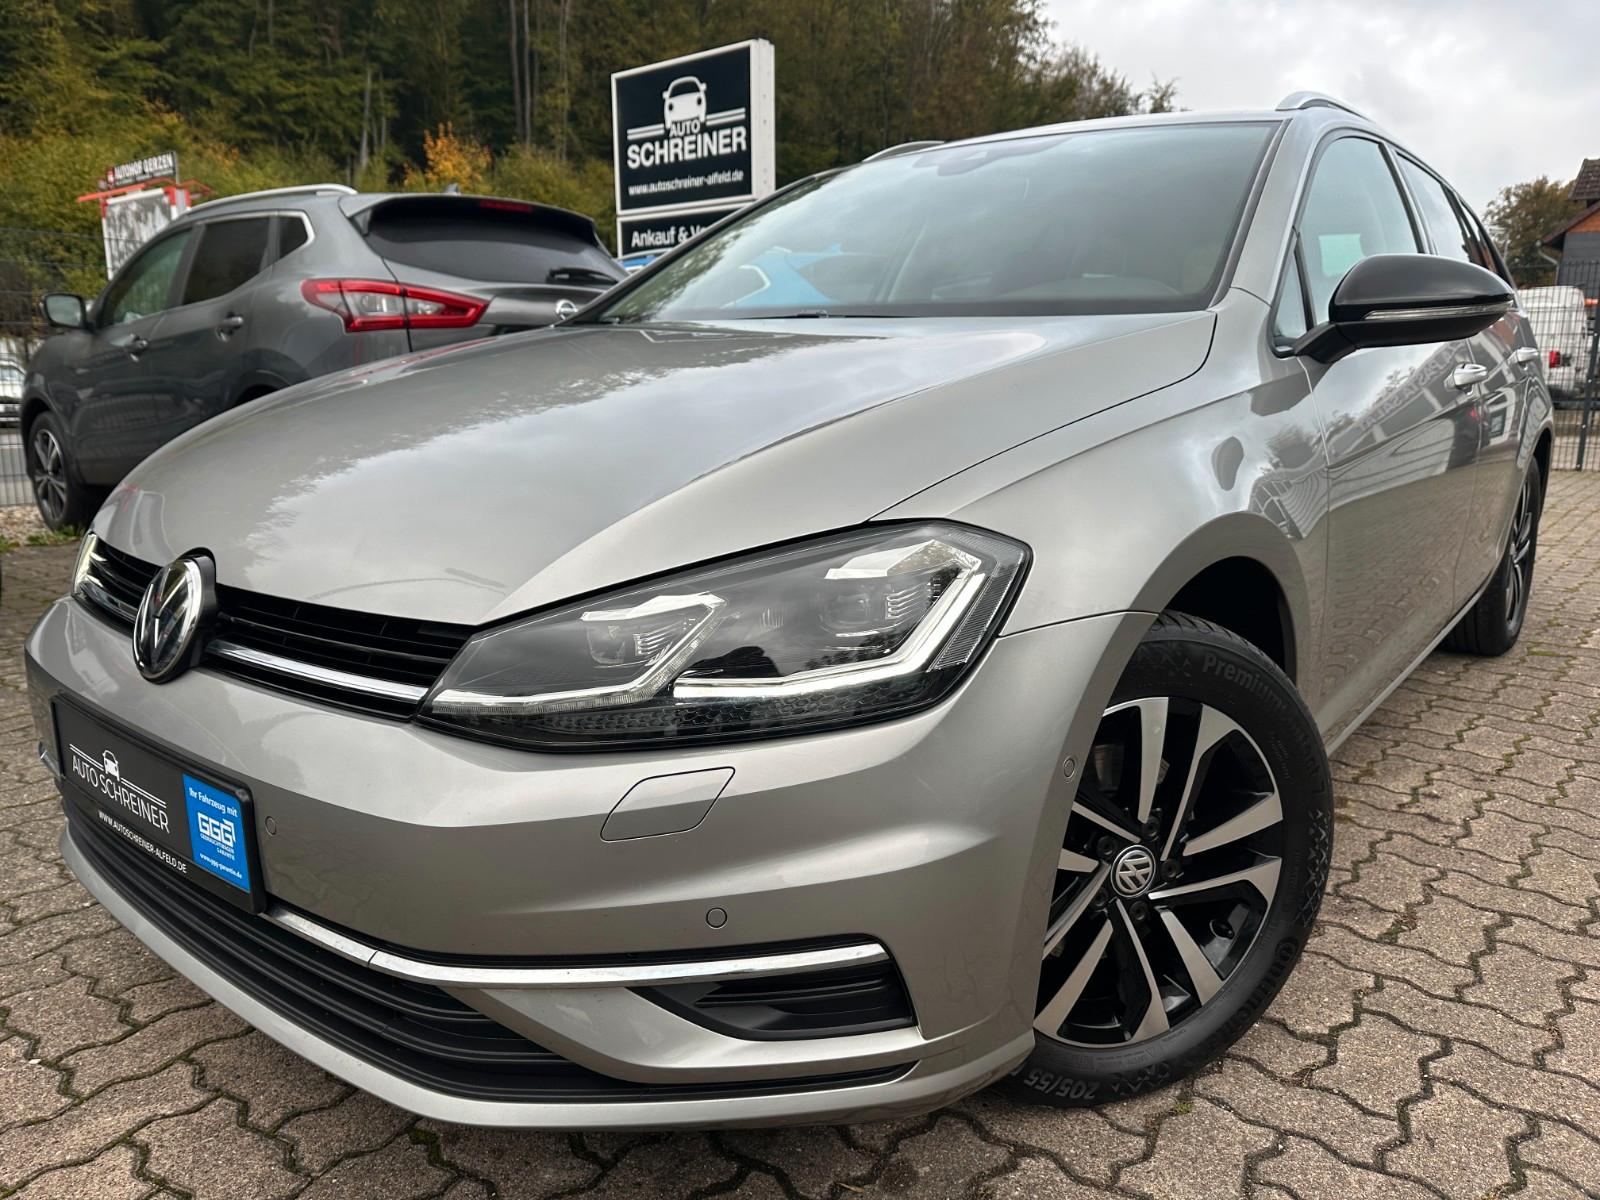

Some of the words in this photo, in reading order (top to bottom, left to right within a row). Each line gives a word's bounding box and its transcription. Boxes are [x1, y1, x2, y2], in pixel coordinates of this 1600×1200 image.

[669, 118, 700, 137] AUTO
[626, 126, 747, 169] SCHREINER
[628, 170, 744, 195] www.autoschreiner-alfeld.de
[631, 226, 676, 248] Ankauf
[677, 226, 690, 243] &
[72, 755, 99, 788] AUTO
[100, 773, 170, 834] SCHREINER
[188, 787, 198, 799] Ihr
[198, 791, 226, 814] Fahrzeug
[226, 805, 239, 818] mit
[98, 810, 187, 874] WWW.AUTOSCHREINER-ALFELD.DE
[1023, 1068, 1101, 1100] 205/55
